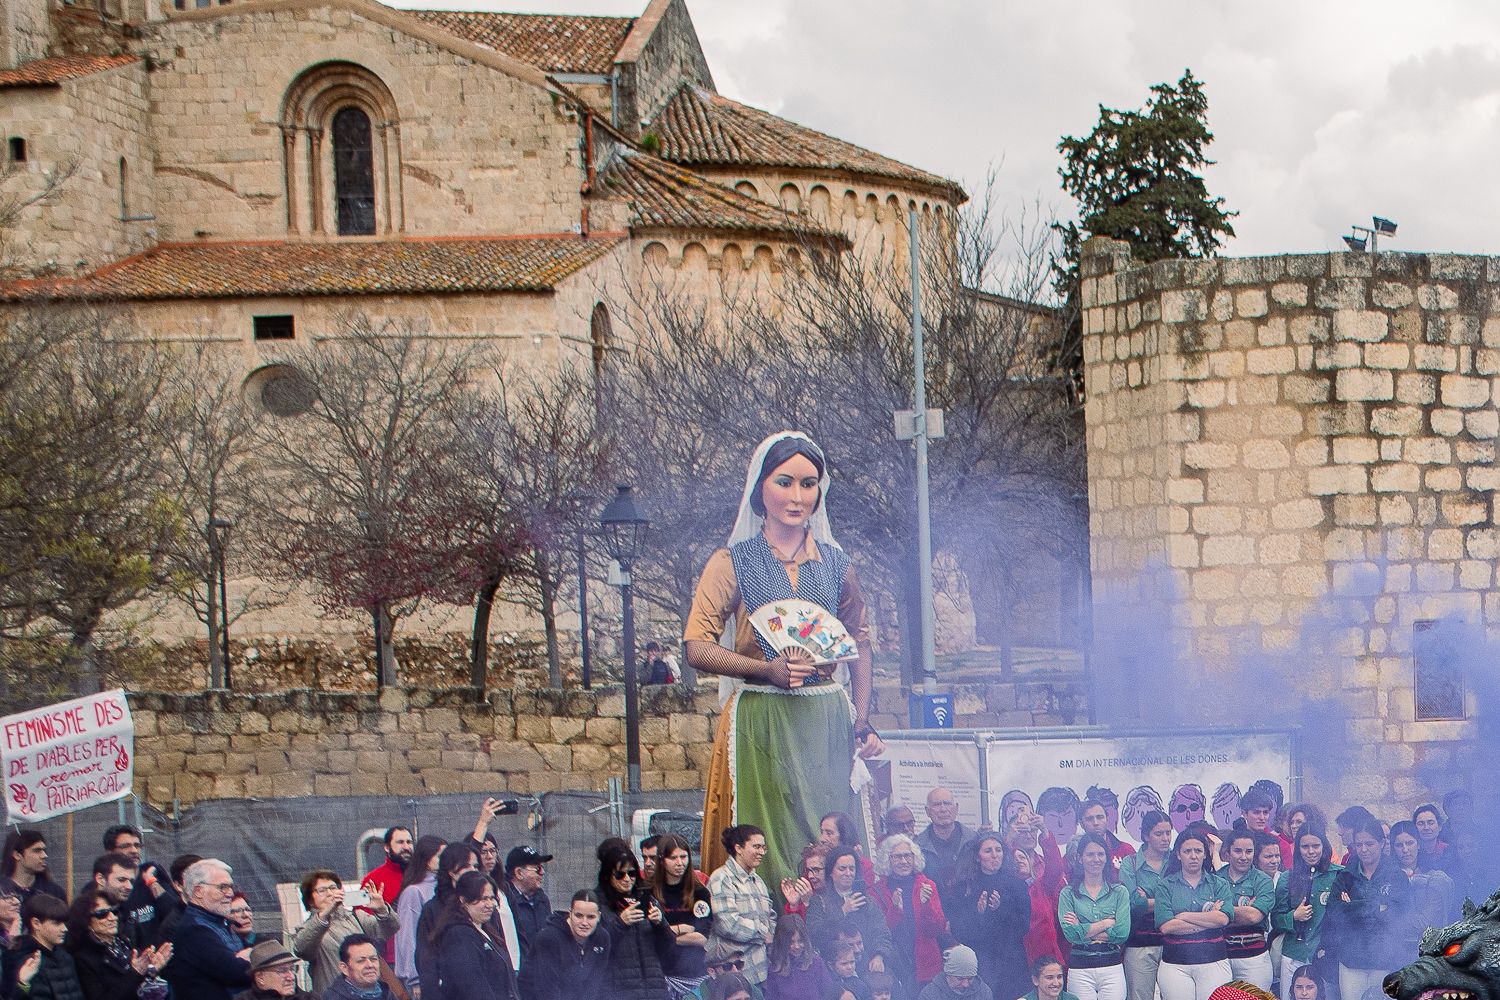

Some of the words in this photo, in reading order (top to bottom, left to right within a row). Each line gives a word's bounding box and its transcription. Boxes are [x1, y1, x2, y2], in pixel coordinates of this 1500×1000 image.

[4, 706, 86, 749] FEMINISME
[94, 700, 123, 728] DES
[9, 756, 29, 778] DE
[36, 741, 92, 770] DIABLES
[95, 735, 120, 758] PER
[1059, 760, 1074, 769] 8M
[1076, 759, 1091, 768] DIA
[1093, 756, 1164, 768] INTERNACIONAL
[1166, 756, 1178, 765] DE
[1180, 755, 1196, 764] LES
[1198, 754, 1228, 764] DONES
[21, 793, 37, 815] el
